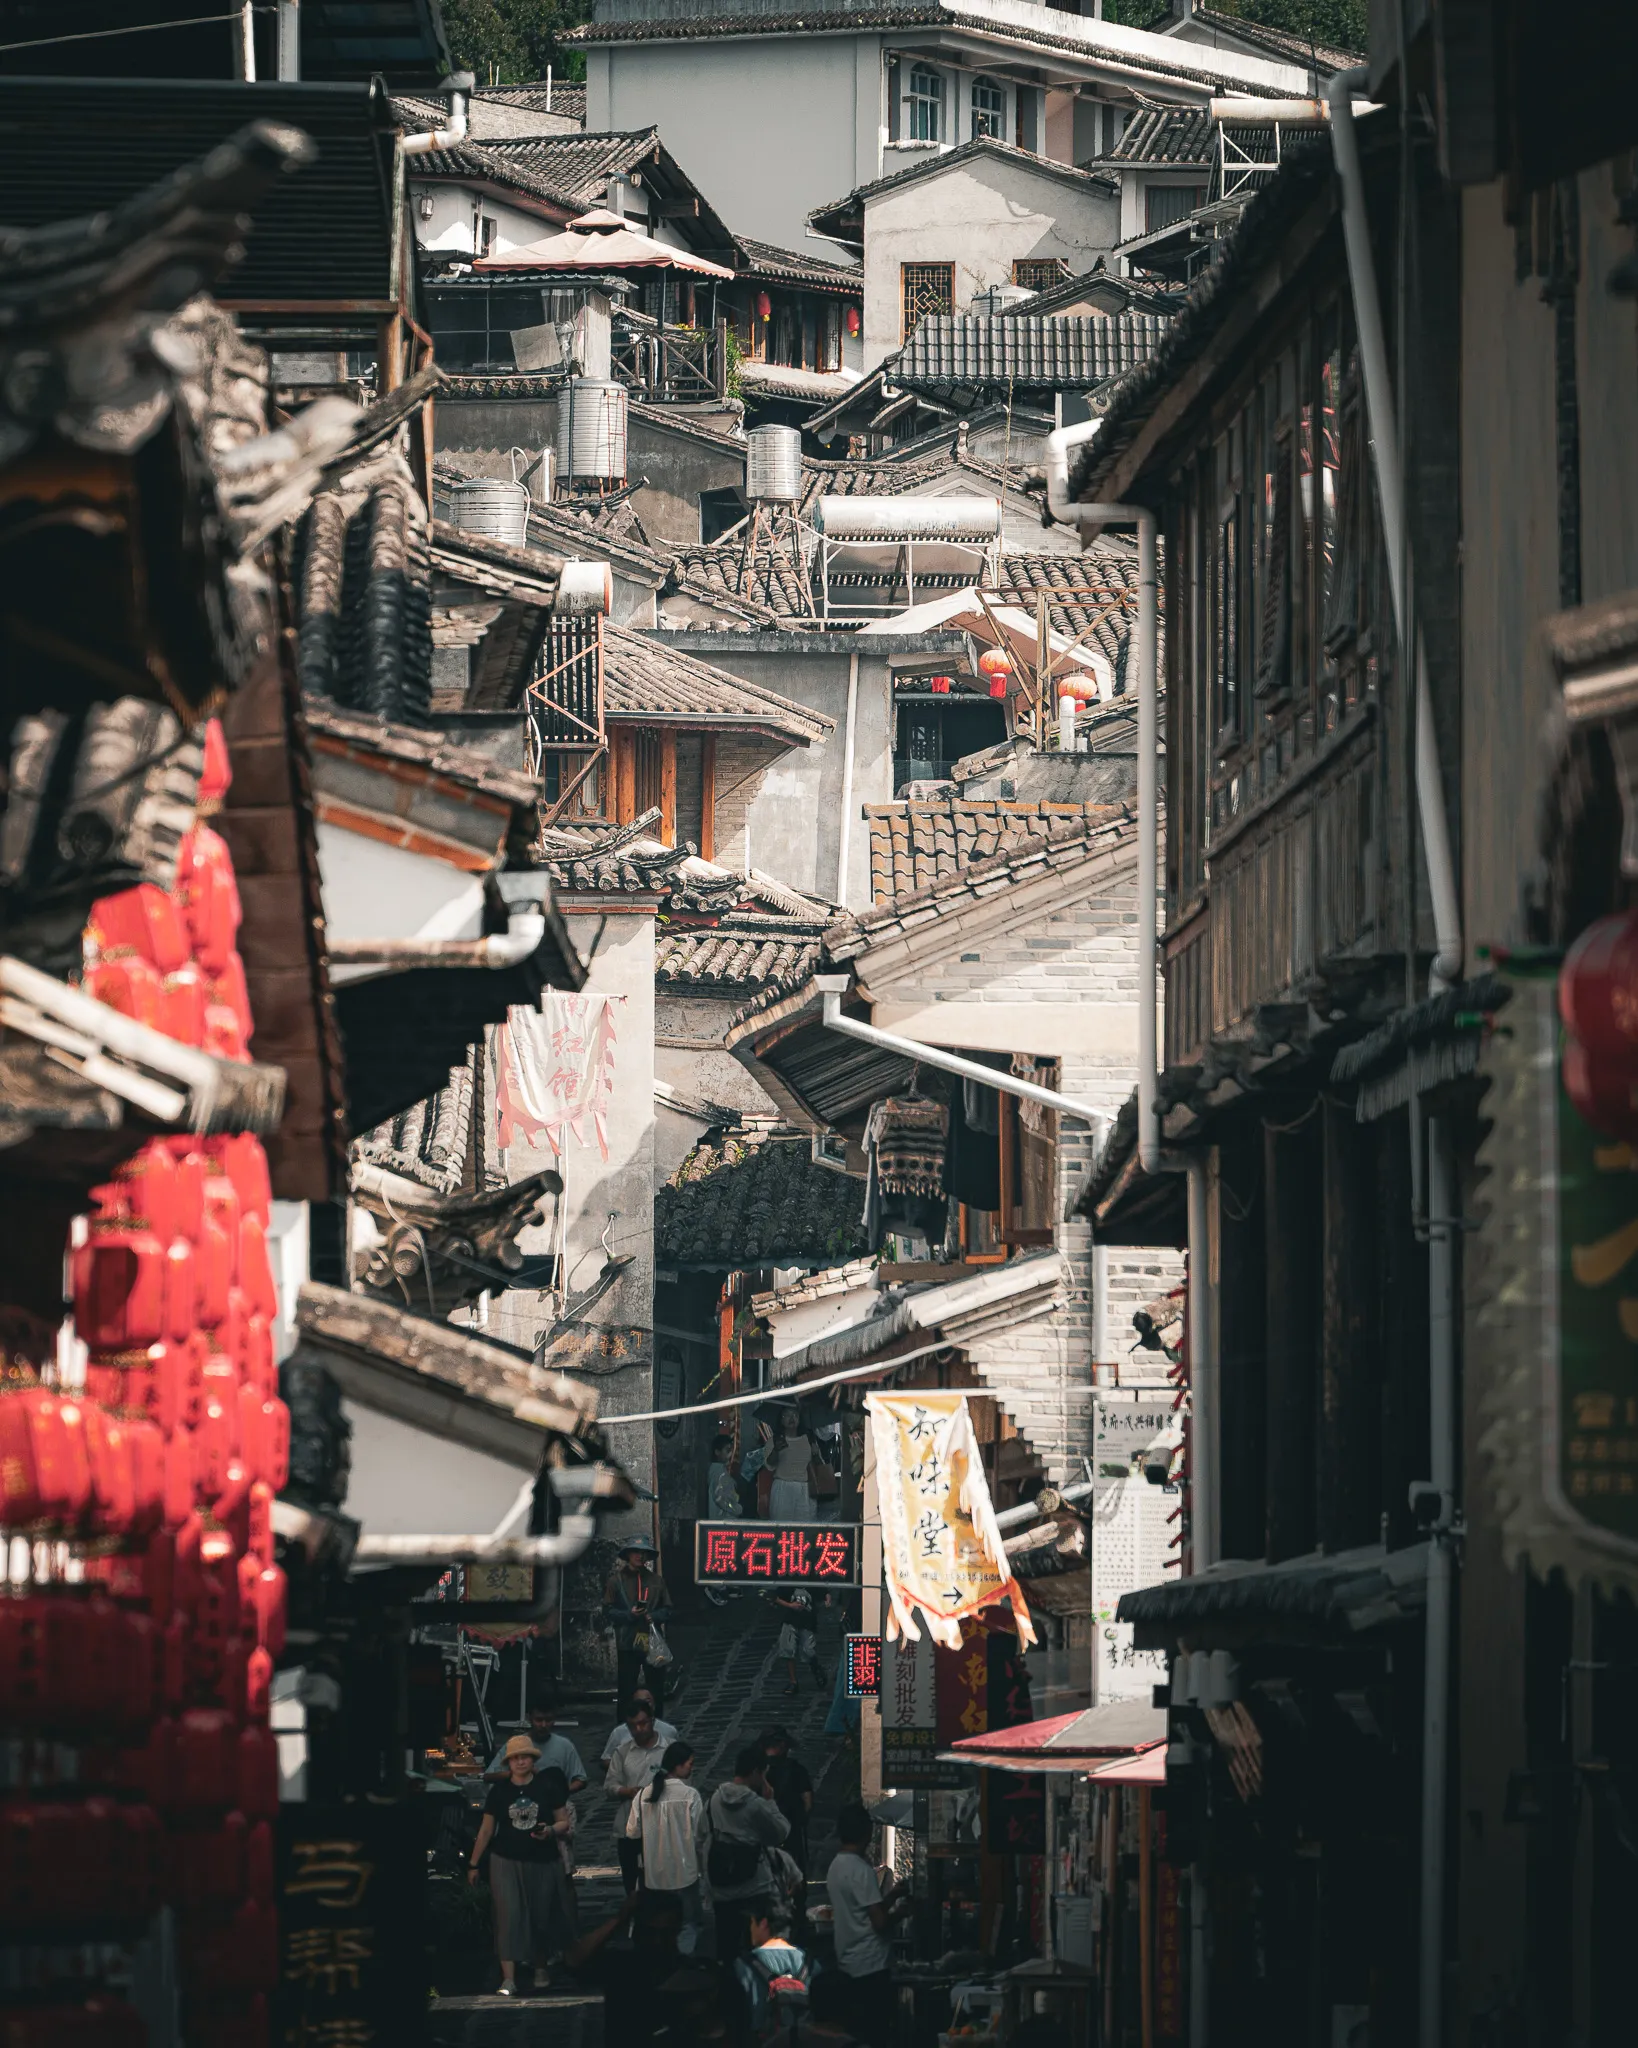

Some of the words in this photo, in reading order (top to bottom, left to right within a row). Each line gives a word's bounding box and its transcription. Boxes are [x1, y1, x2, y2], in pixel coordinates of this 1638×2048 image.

[907, 1405, 950, 1558] 知味堂
[704, 1530, 849, 1577] 原石批发
